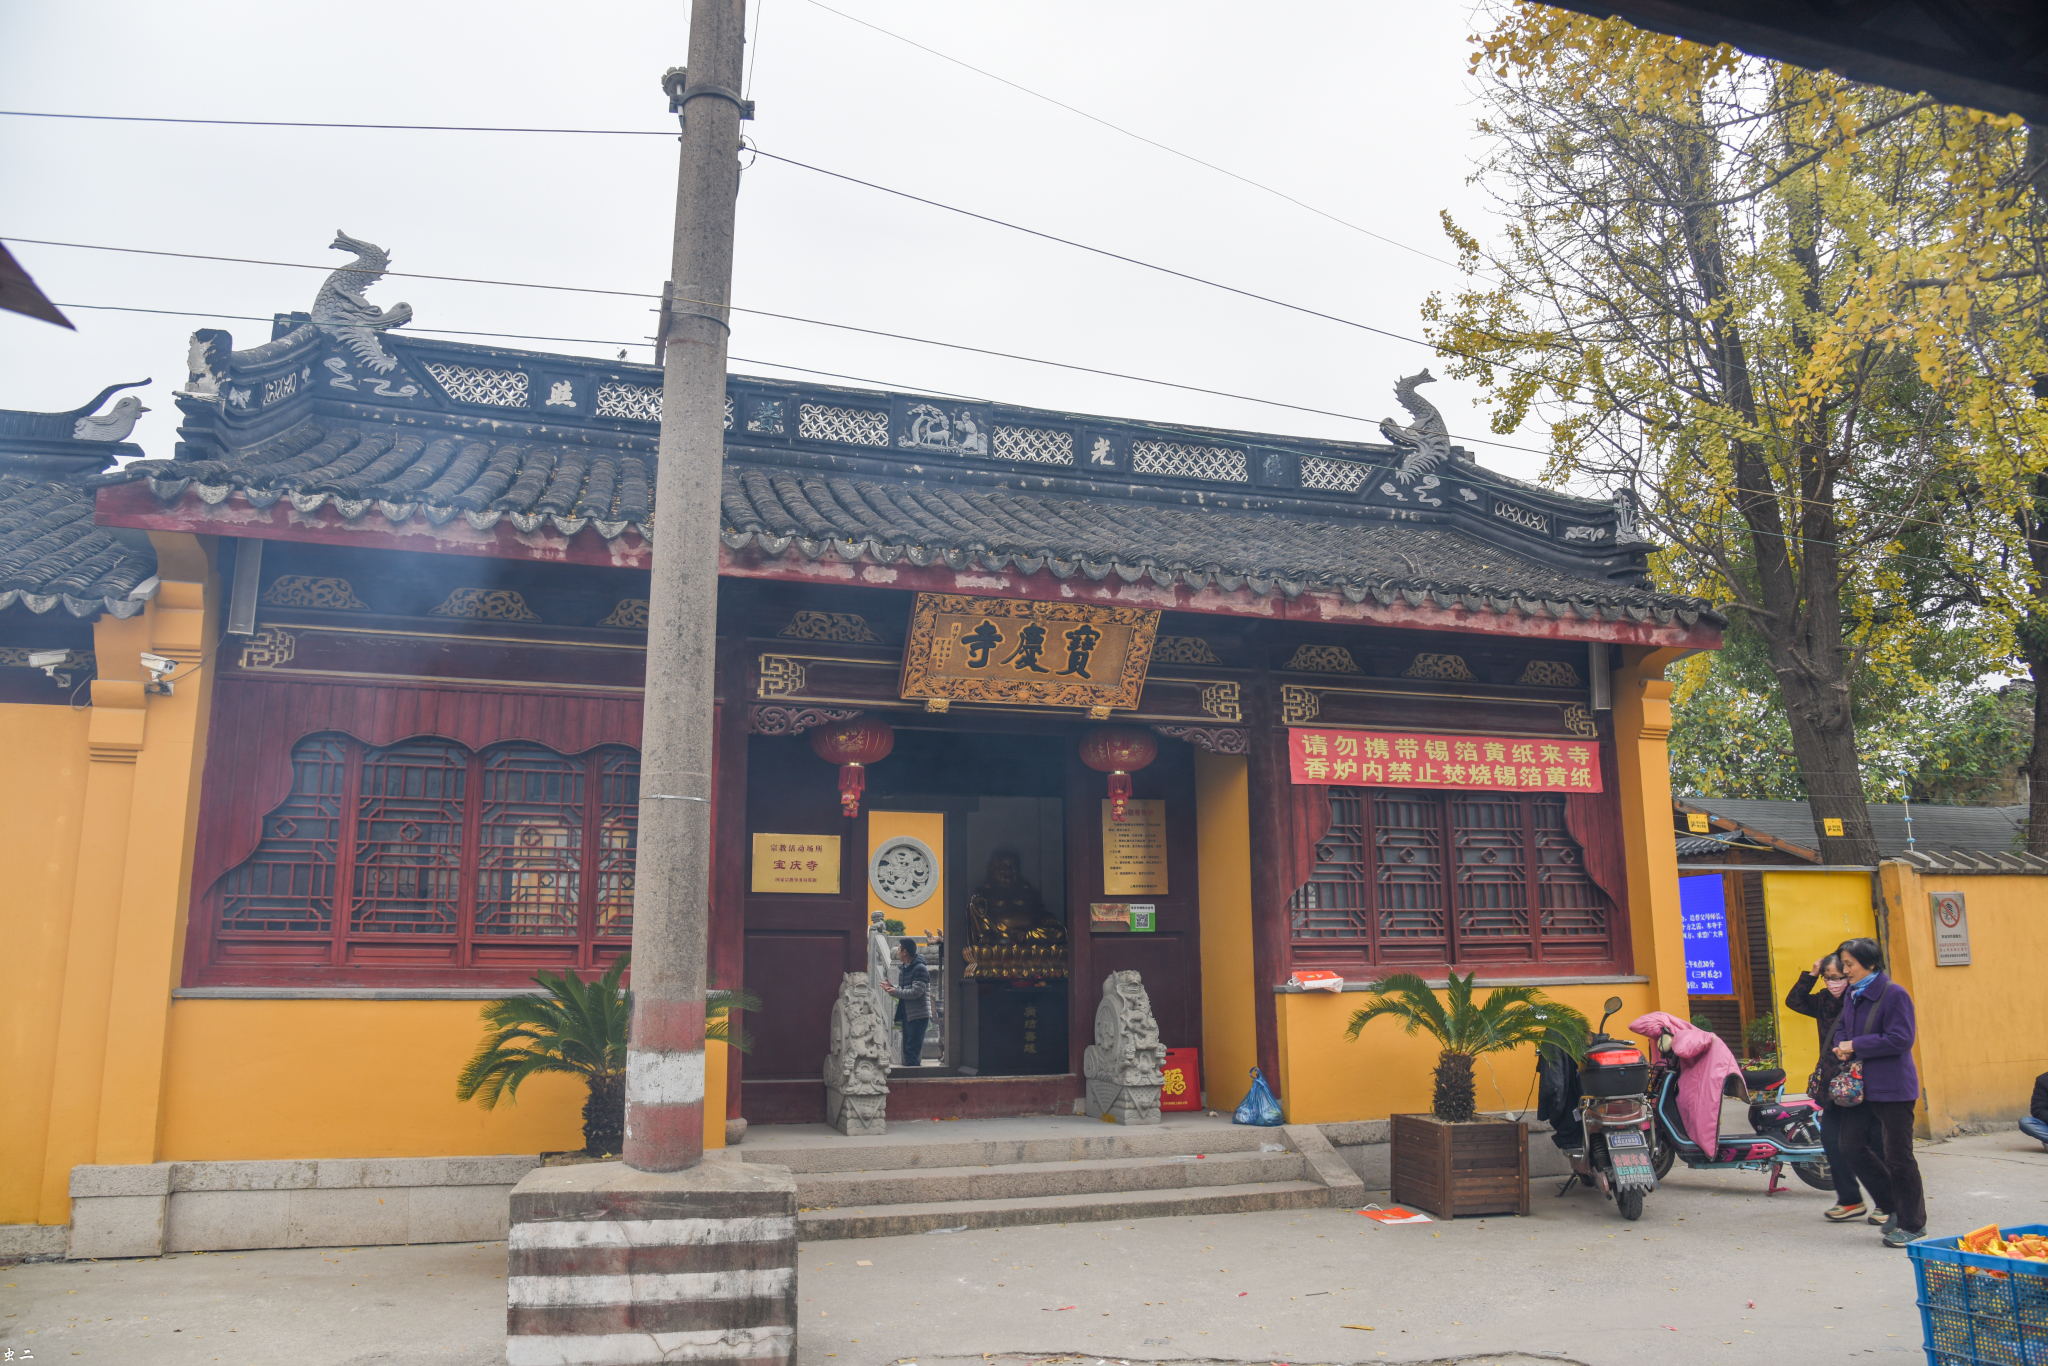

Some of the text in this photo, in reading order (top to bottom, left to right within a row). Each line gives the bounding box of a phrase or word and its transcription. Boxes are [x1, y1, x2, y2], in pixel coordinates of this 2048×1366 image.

[545, 379, 577, 408] 照
[1090, 435, 1116, 466] 光
[961, 619, 1102, 680] 寶慶寺
[1301, 733, 1591, 766] 请勿携带锡箔黄纸来寺
[1303, 757, 1592, 788] 香炉内禁止焚烧锡箔黄纸
[771, 844, 822, 853] 宗教活动场所
[773, 860, 818, 871] 宝庆寺
[1162, 1068, 1187, 1096] 福
